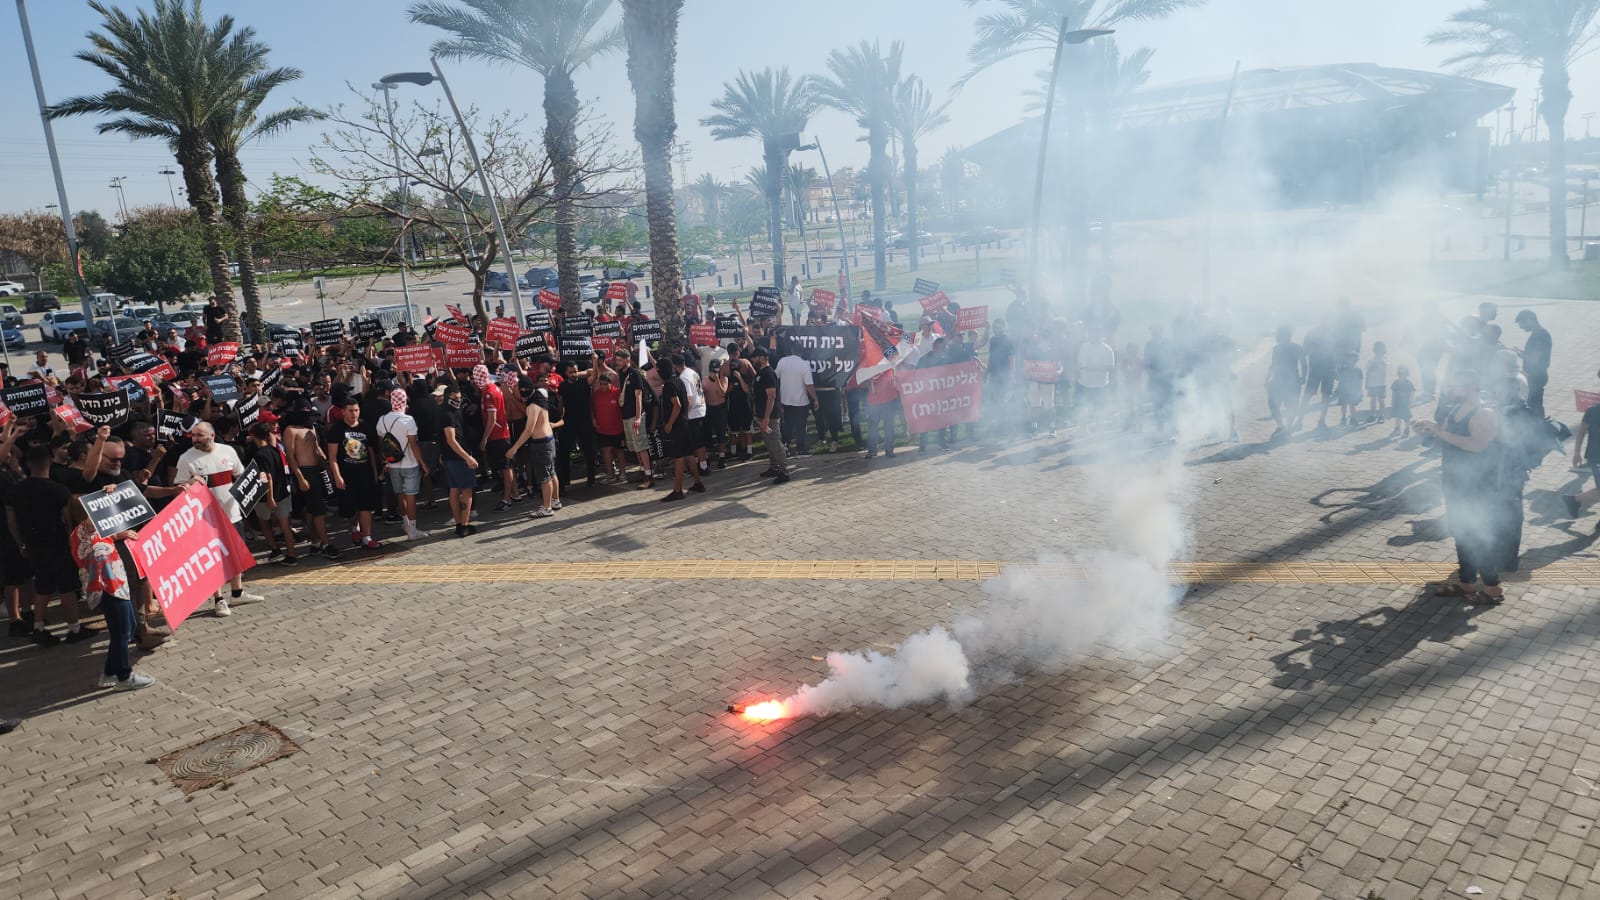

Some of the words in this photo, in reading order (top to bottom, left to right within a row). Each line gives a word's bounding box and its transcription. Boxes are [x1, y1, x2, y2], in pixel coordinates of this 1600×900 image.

[633, 323, 660, 331] מושחתים
[821, 336, 844, 349] בית
[834, 356, 854, 373] של
[902, 378, 926, 396] עם
[928, 370, 978, 391] אליפות
[6, 388, 43, 400] ההתאחדות
[103, 396, 121, 408] בית
[31, 398, 46, 408] לבית
[79, 398, 101, 409] הדין
[912, 395, 971, 419] כוכב(ית)
[114, 407, 127, 419] של
[87, 487, 136, 512] מושחתים
[97, 504, 148, 531] נמאסתם!
[164, 494, 205, 544] לסגור
[142, 529, 167, 567] את
[157, 537, 230, 609] הכדורגל!
